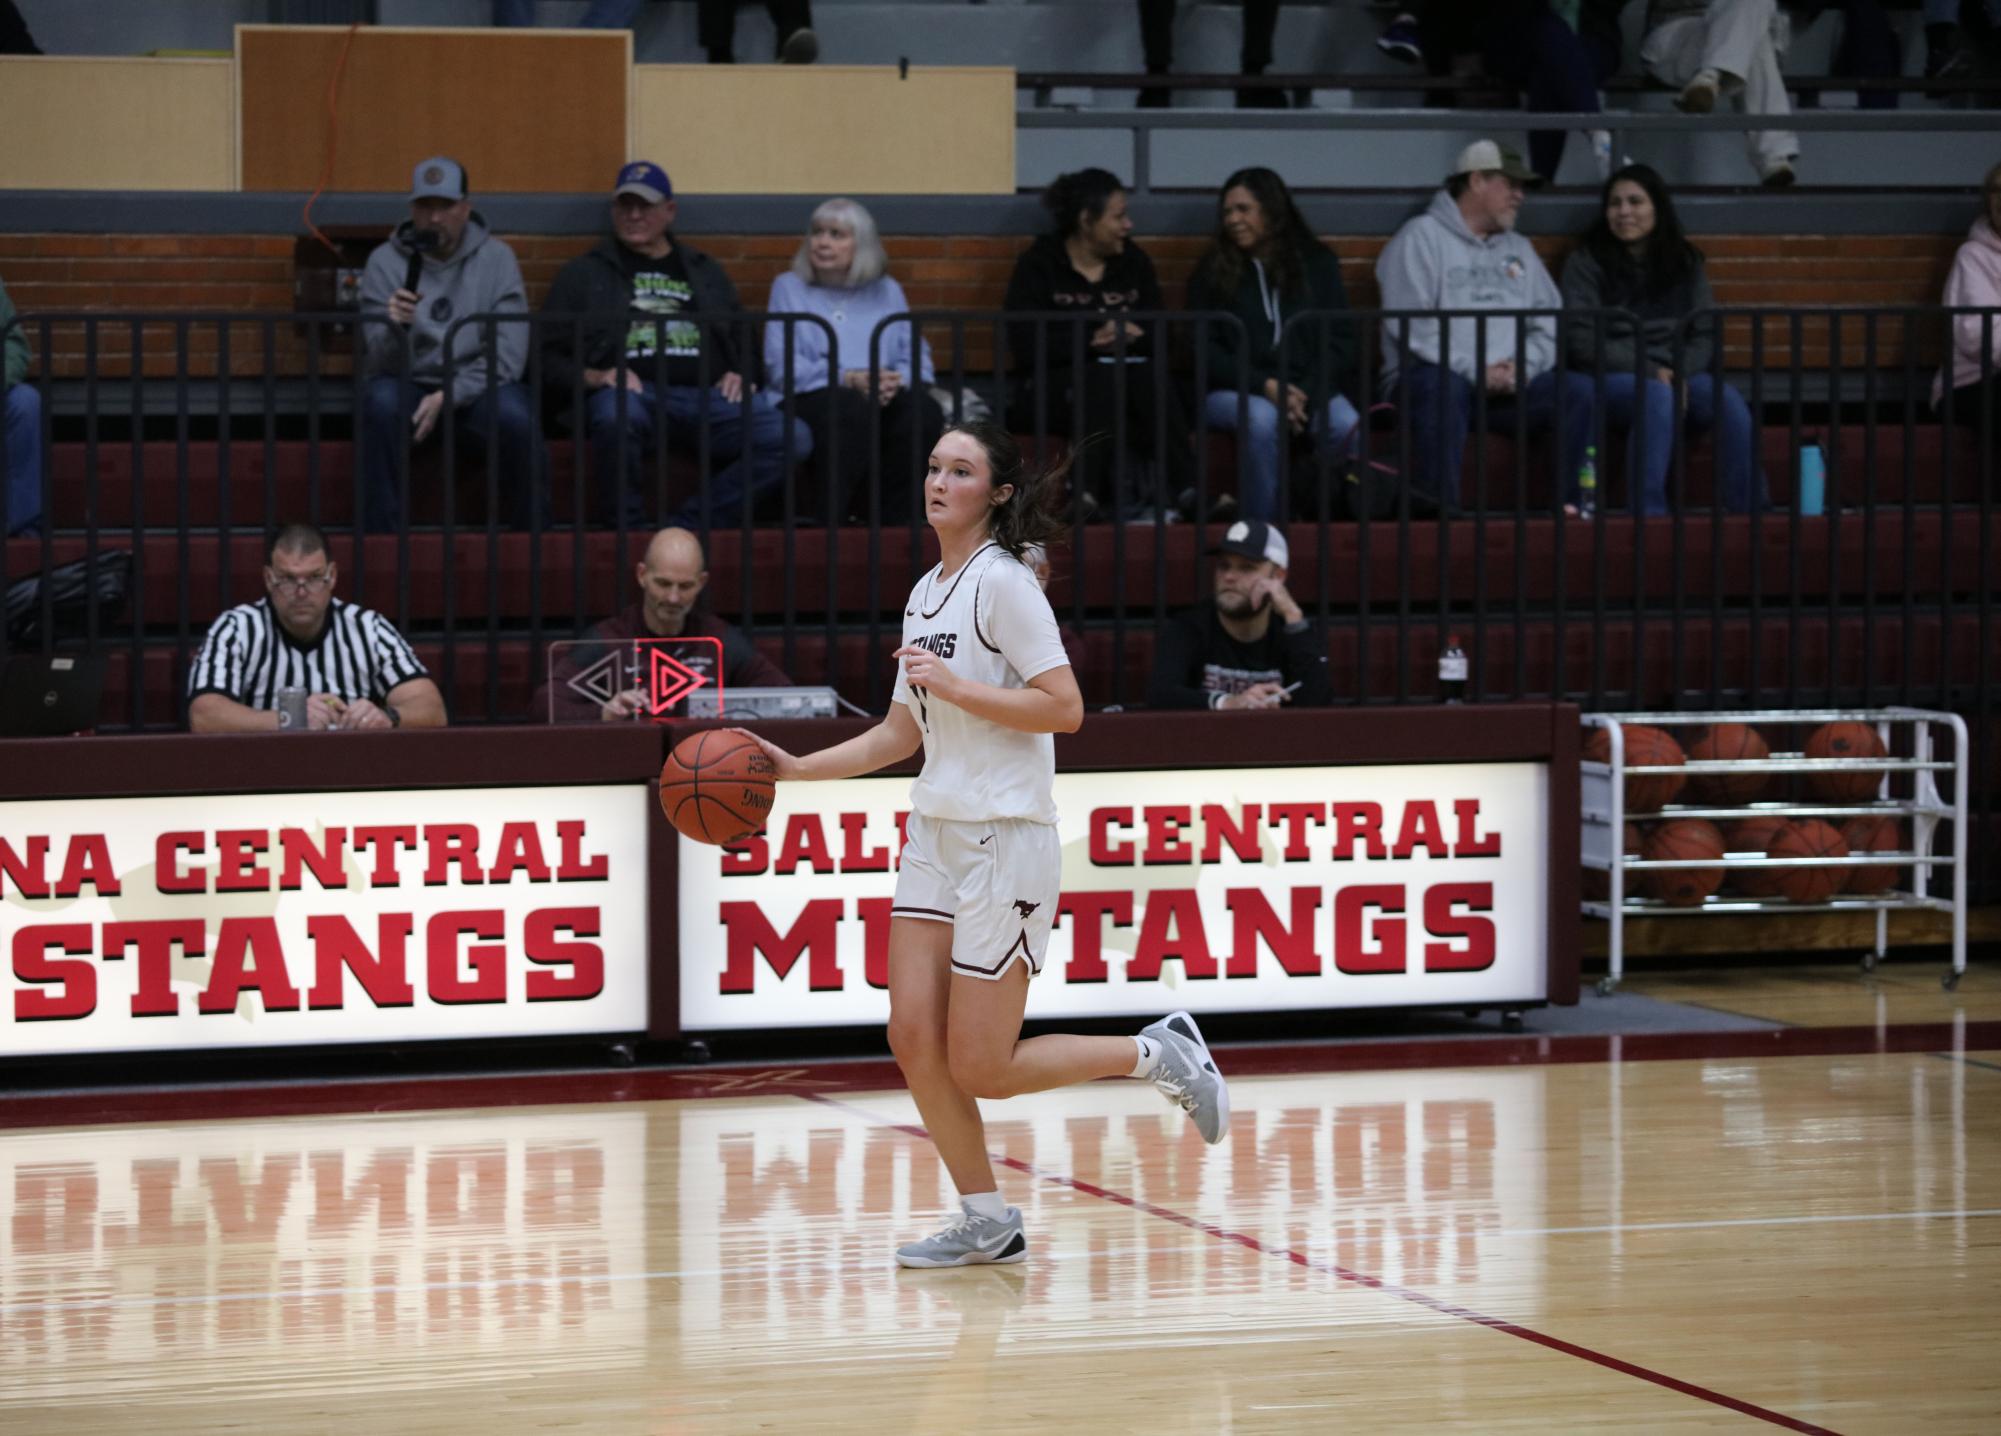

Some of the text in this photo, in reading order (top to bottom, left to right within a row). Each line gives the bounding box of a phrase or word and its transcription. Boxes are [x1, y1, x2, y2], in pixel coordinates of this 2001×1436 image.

[155, 819, 610, 895] CENTRAL
[1088, 798, 1502, 868] CENTRAL
[11, 905, 605, 1023] STANGS
